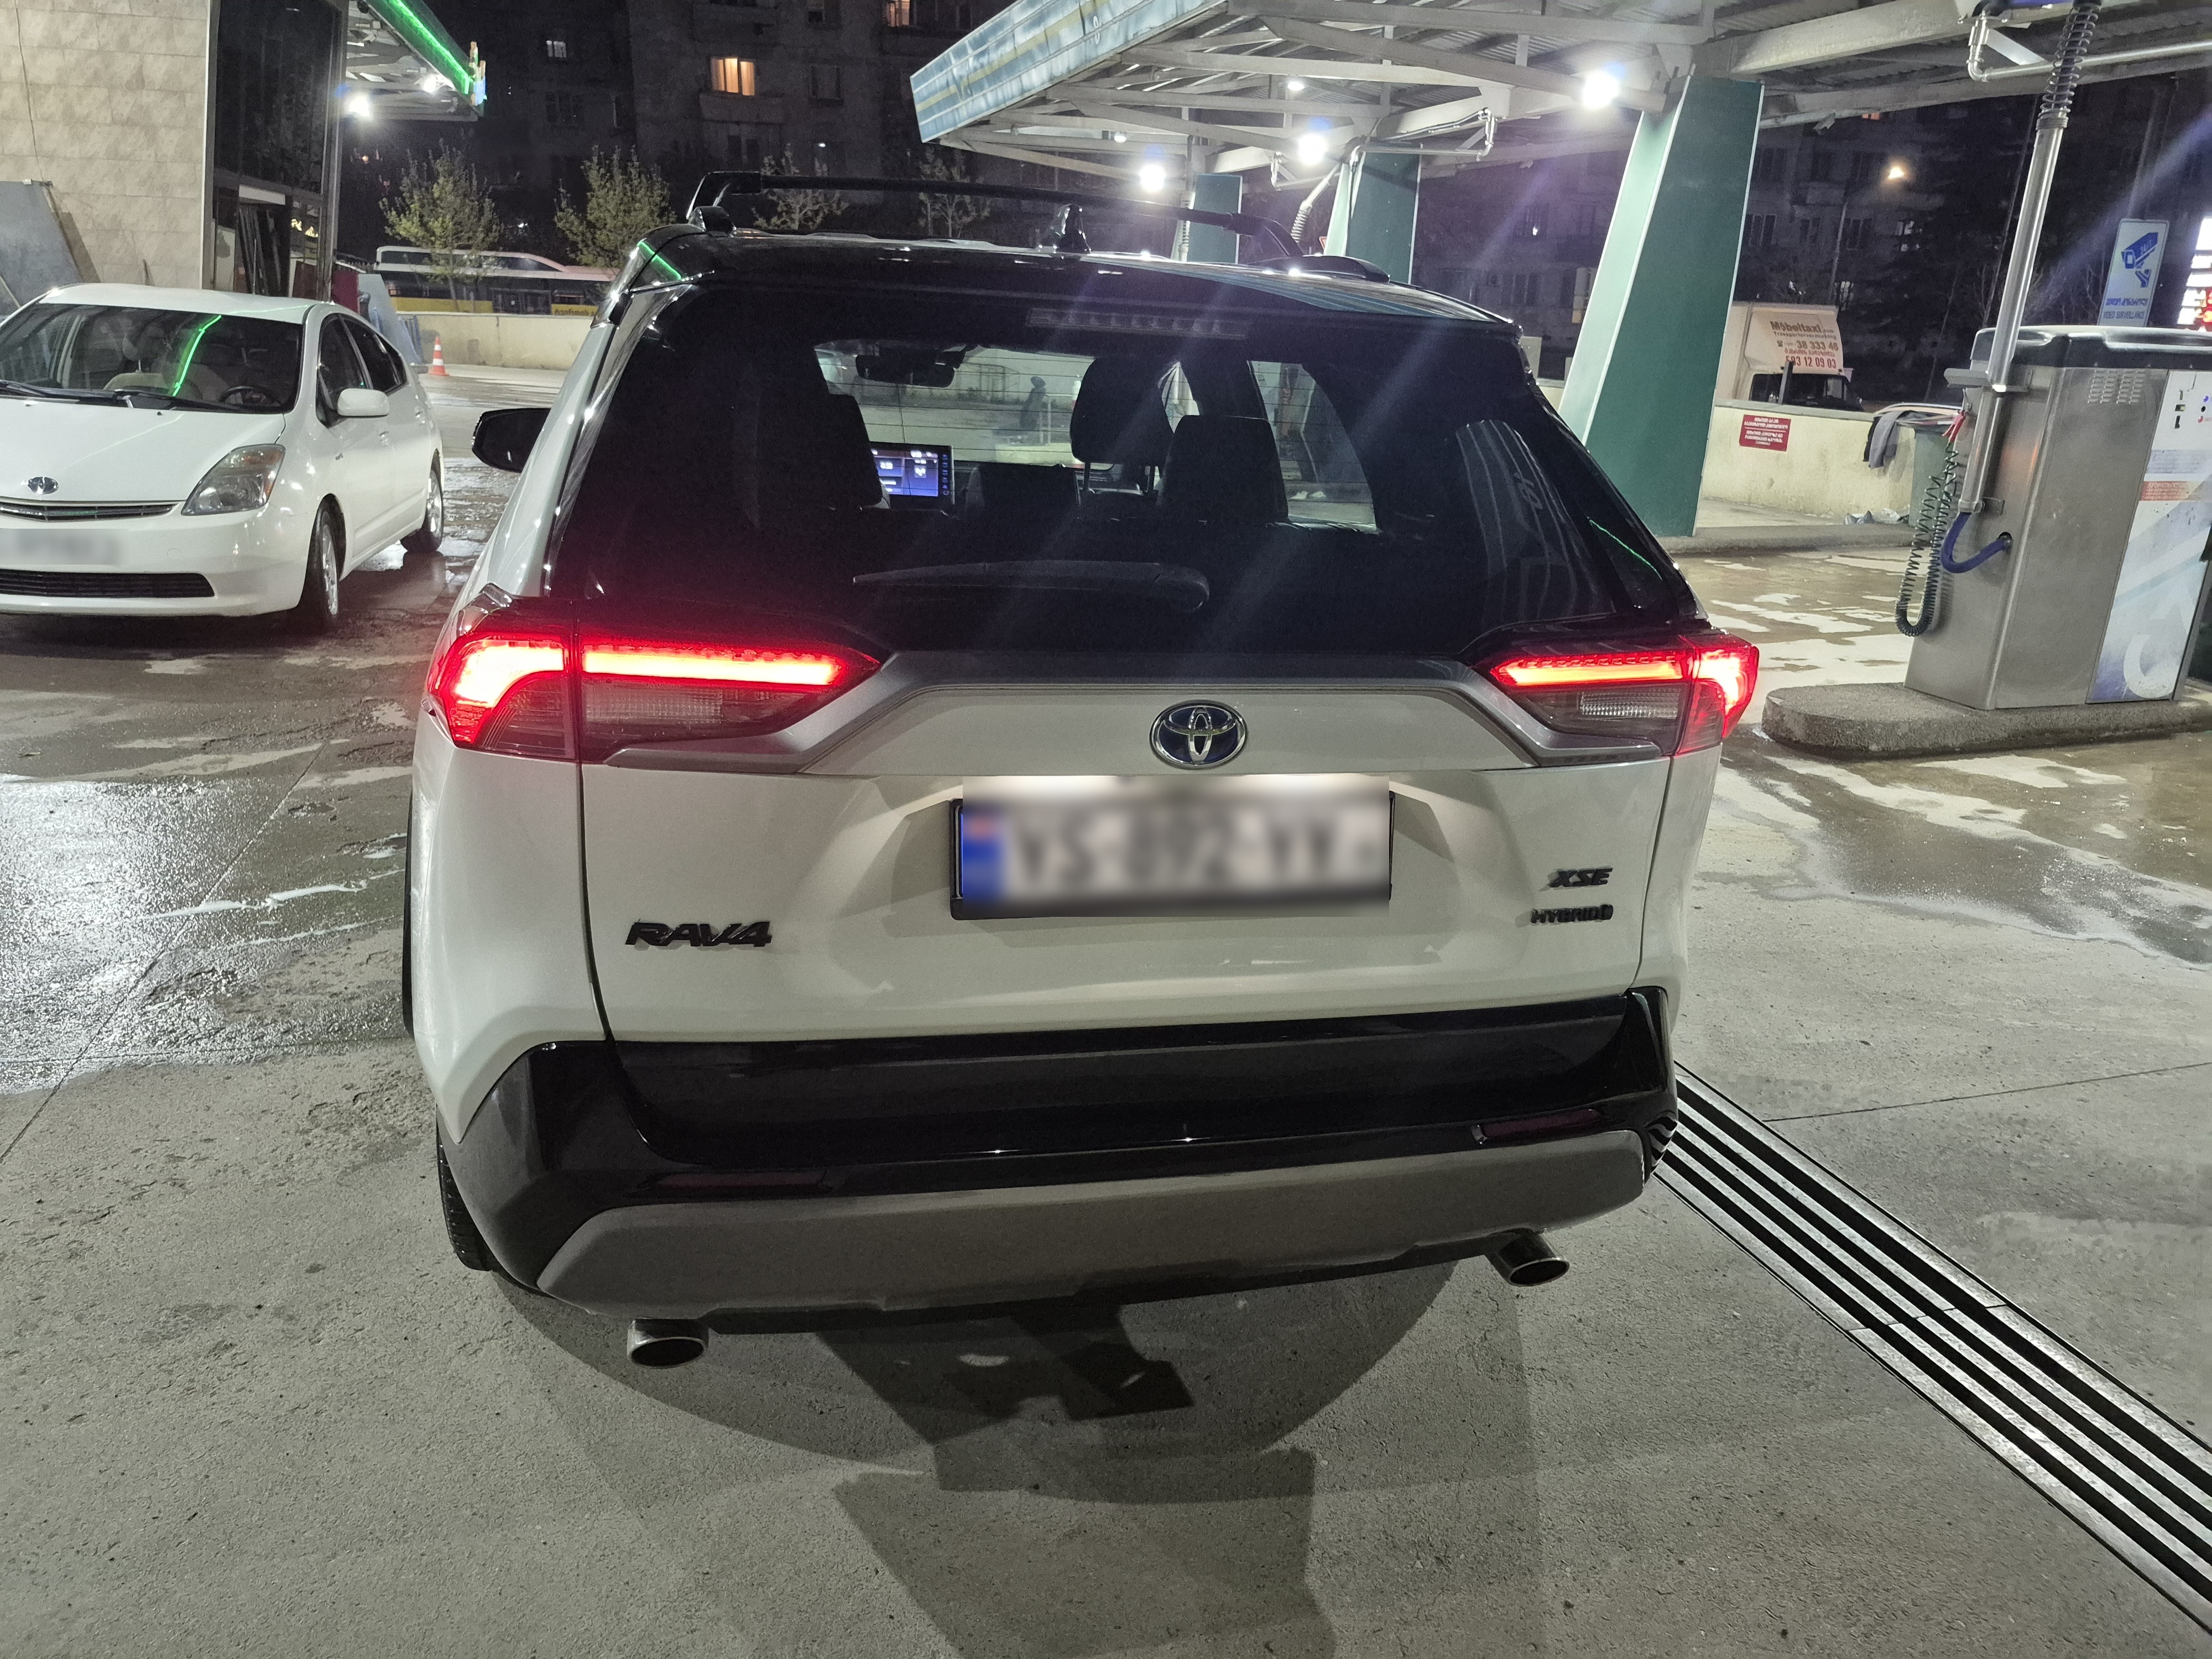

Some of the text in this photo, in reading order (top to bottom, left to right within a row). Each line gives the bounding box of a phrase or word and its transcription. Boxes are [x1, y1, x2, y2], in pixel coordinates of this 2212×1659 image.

[2103, 310, 2146, 319] VIDEO SURVEILLANCE
[1796, 340, 1808, 349] 38
[1809, 341, 1826, 350] 333
[1804, 357, 1813, 367] 12
[1815, 357, 1825, 368] 09
[1827, 358, 1837, 369] 03
[1550, 868, 1613, 888] XSE
[1530, 904, 1614, 924] HYBRID
[625, 921, 773, 947] RAV4
